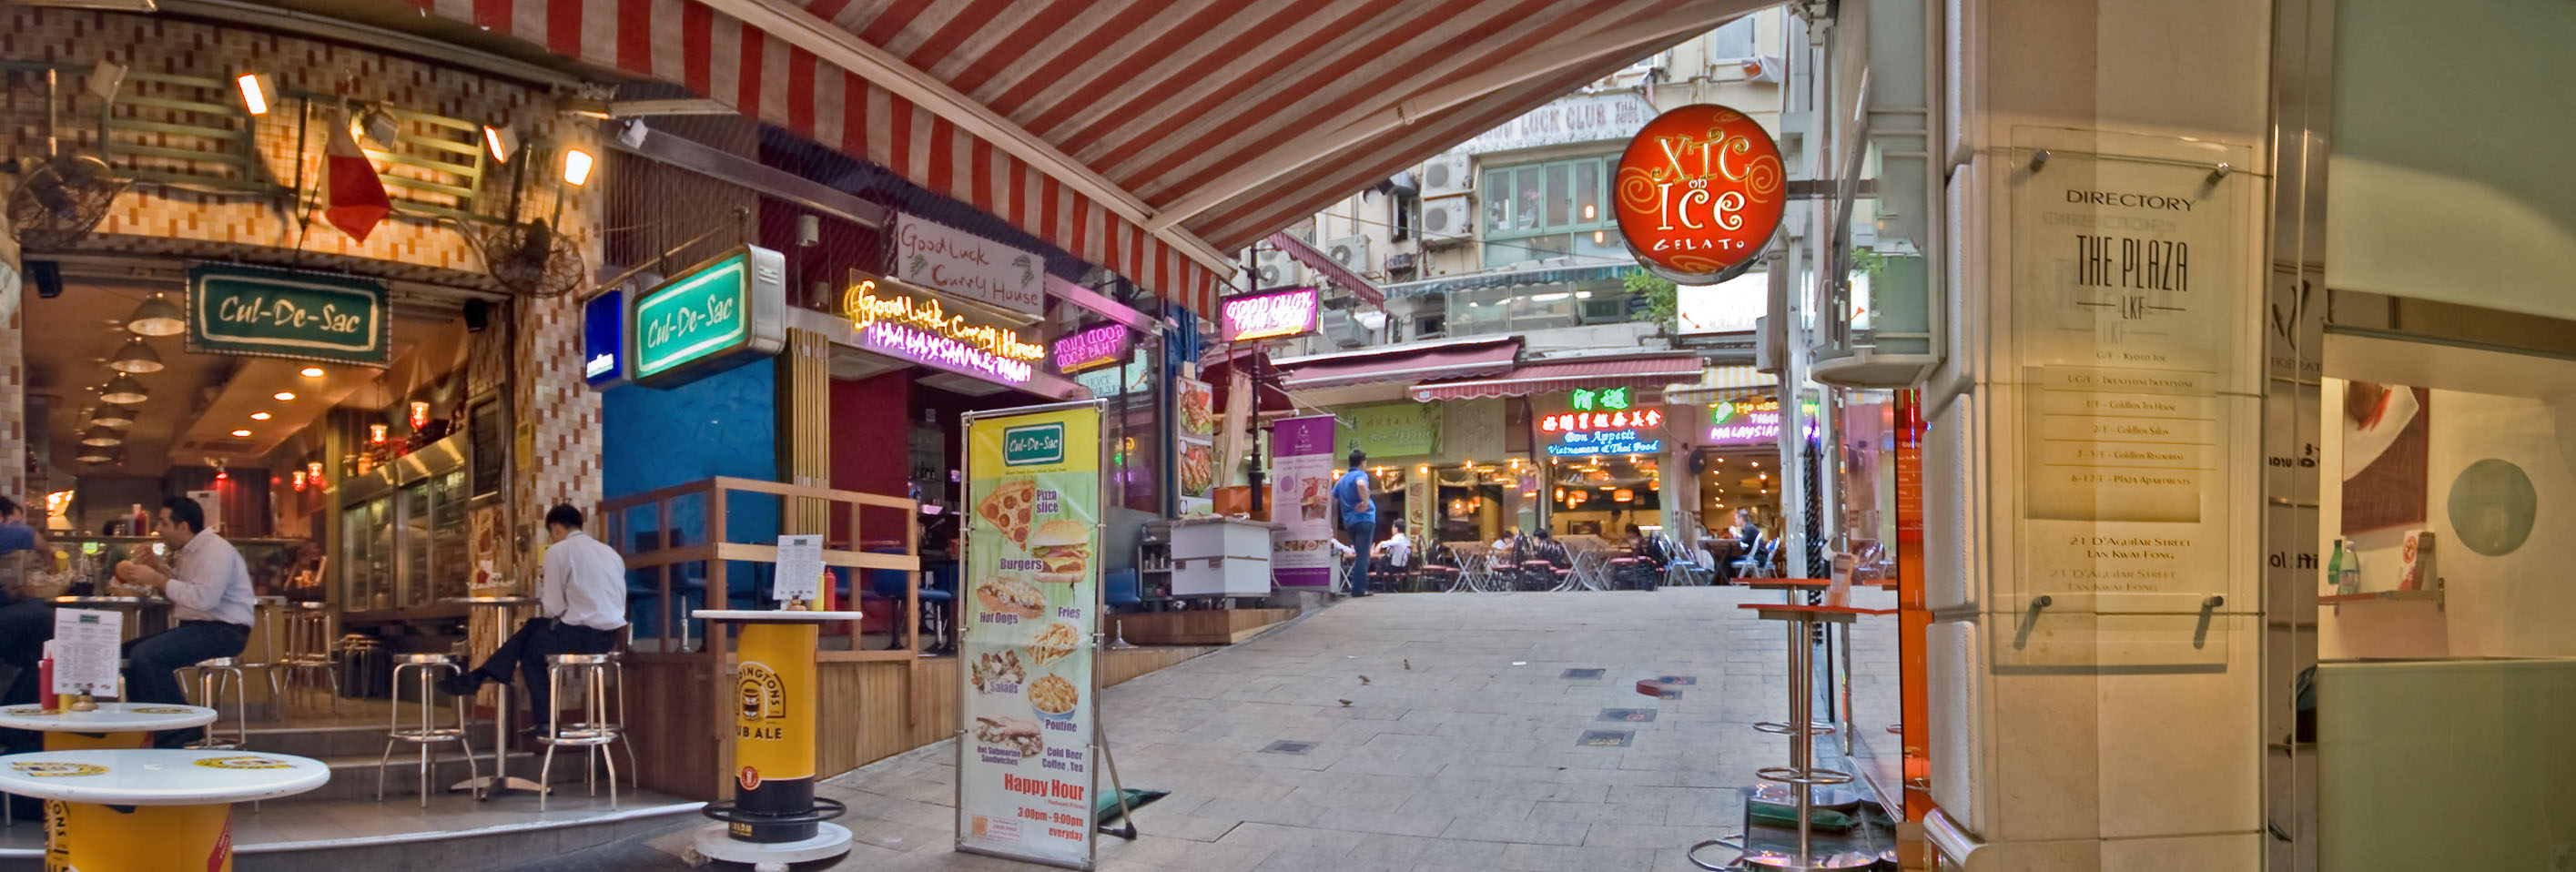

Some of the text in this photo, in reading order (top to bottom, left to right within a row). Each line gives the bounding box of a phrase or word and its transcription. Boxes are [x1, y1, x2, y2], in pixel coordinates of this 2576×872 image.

[1566, 104, 1606, 130] CLUB
[1651, 127, 1749, 184] XTC
[2066, 189, 2193, 212] DIRECTORY
[901, 223, 947, 259] Good
[1653, 238, 1745, 251] GELATO
[2076, 235, 2113, 288] THE
[2122, 238, 2187, 292] PLAZA
[931, 263, 1039, 305] Curry House
[219, 295, 360, 333] Cul-De-Sac
[1226, 297, 1269, 319] GOOD
[2122, 296, 2145, 320] LKF
[647, 294, 733, 350] Cul-De-Sac
[1009, 435, 1059, 452] Cul-De-Sac
[1036, 489, 1057, 502] Pizza
[1036, 502, 1059, 513] slice
[999, 558, 1043, 572] Burgers
[979, 612, 1019, 625] Hot Dogs
[1058, 606, 1080, 620] Fries
[737, 665, 780, 705] DINGTONS
[989, 682, 1019, 695] Salads
[737, 725, 783, 739] UB ALE
[1045, 718, 1077, 733] Poutine
[1047, 746, 1083, 761] Cold Beer
[1070, 762, 1083, 774] Tea
[1004, 774, 1084, 801] Happy Hour
[1018, 806, 1048, 823] 3:00pm
[1053, 810, 1084, 827] 9:00pm
[1049, 826, 1083, 842] everyday
